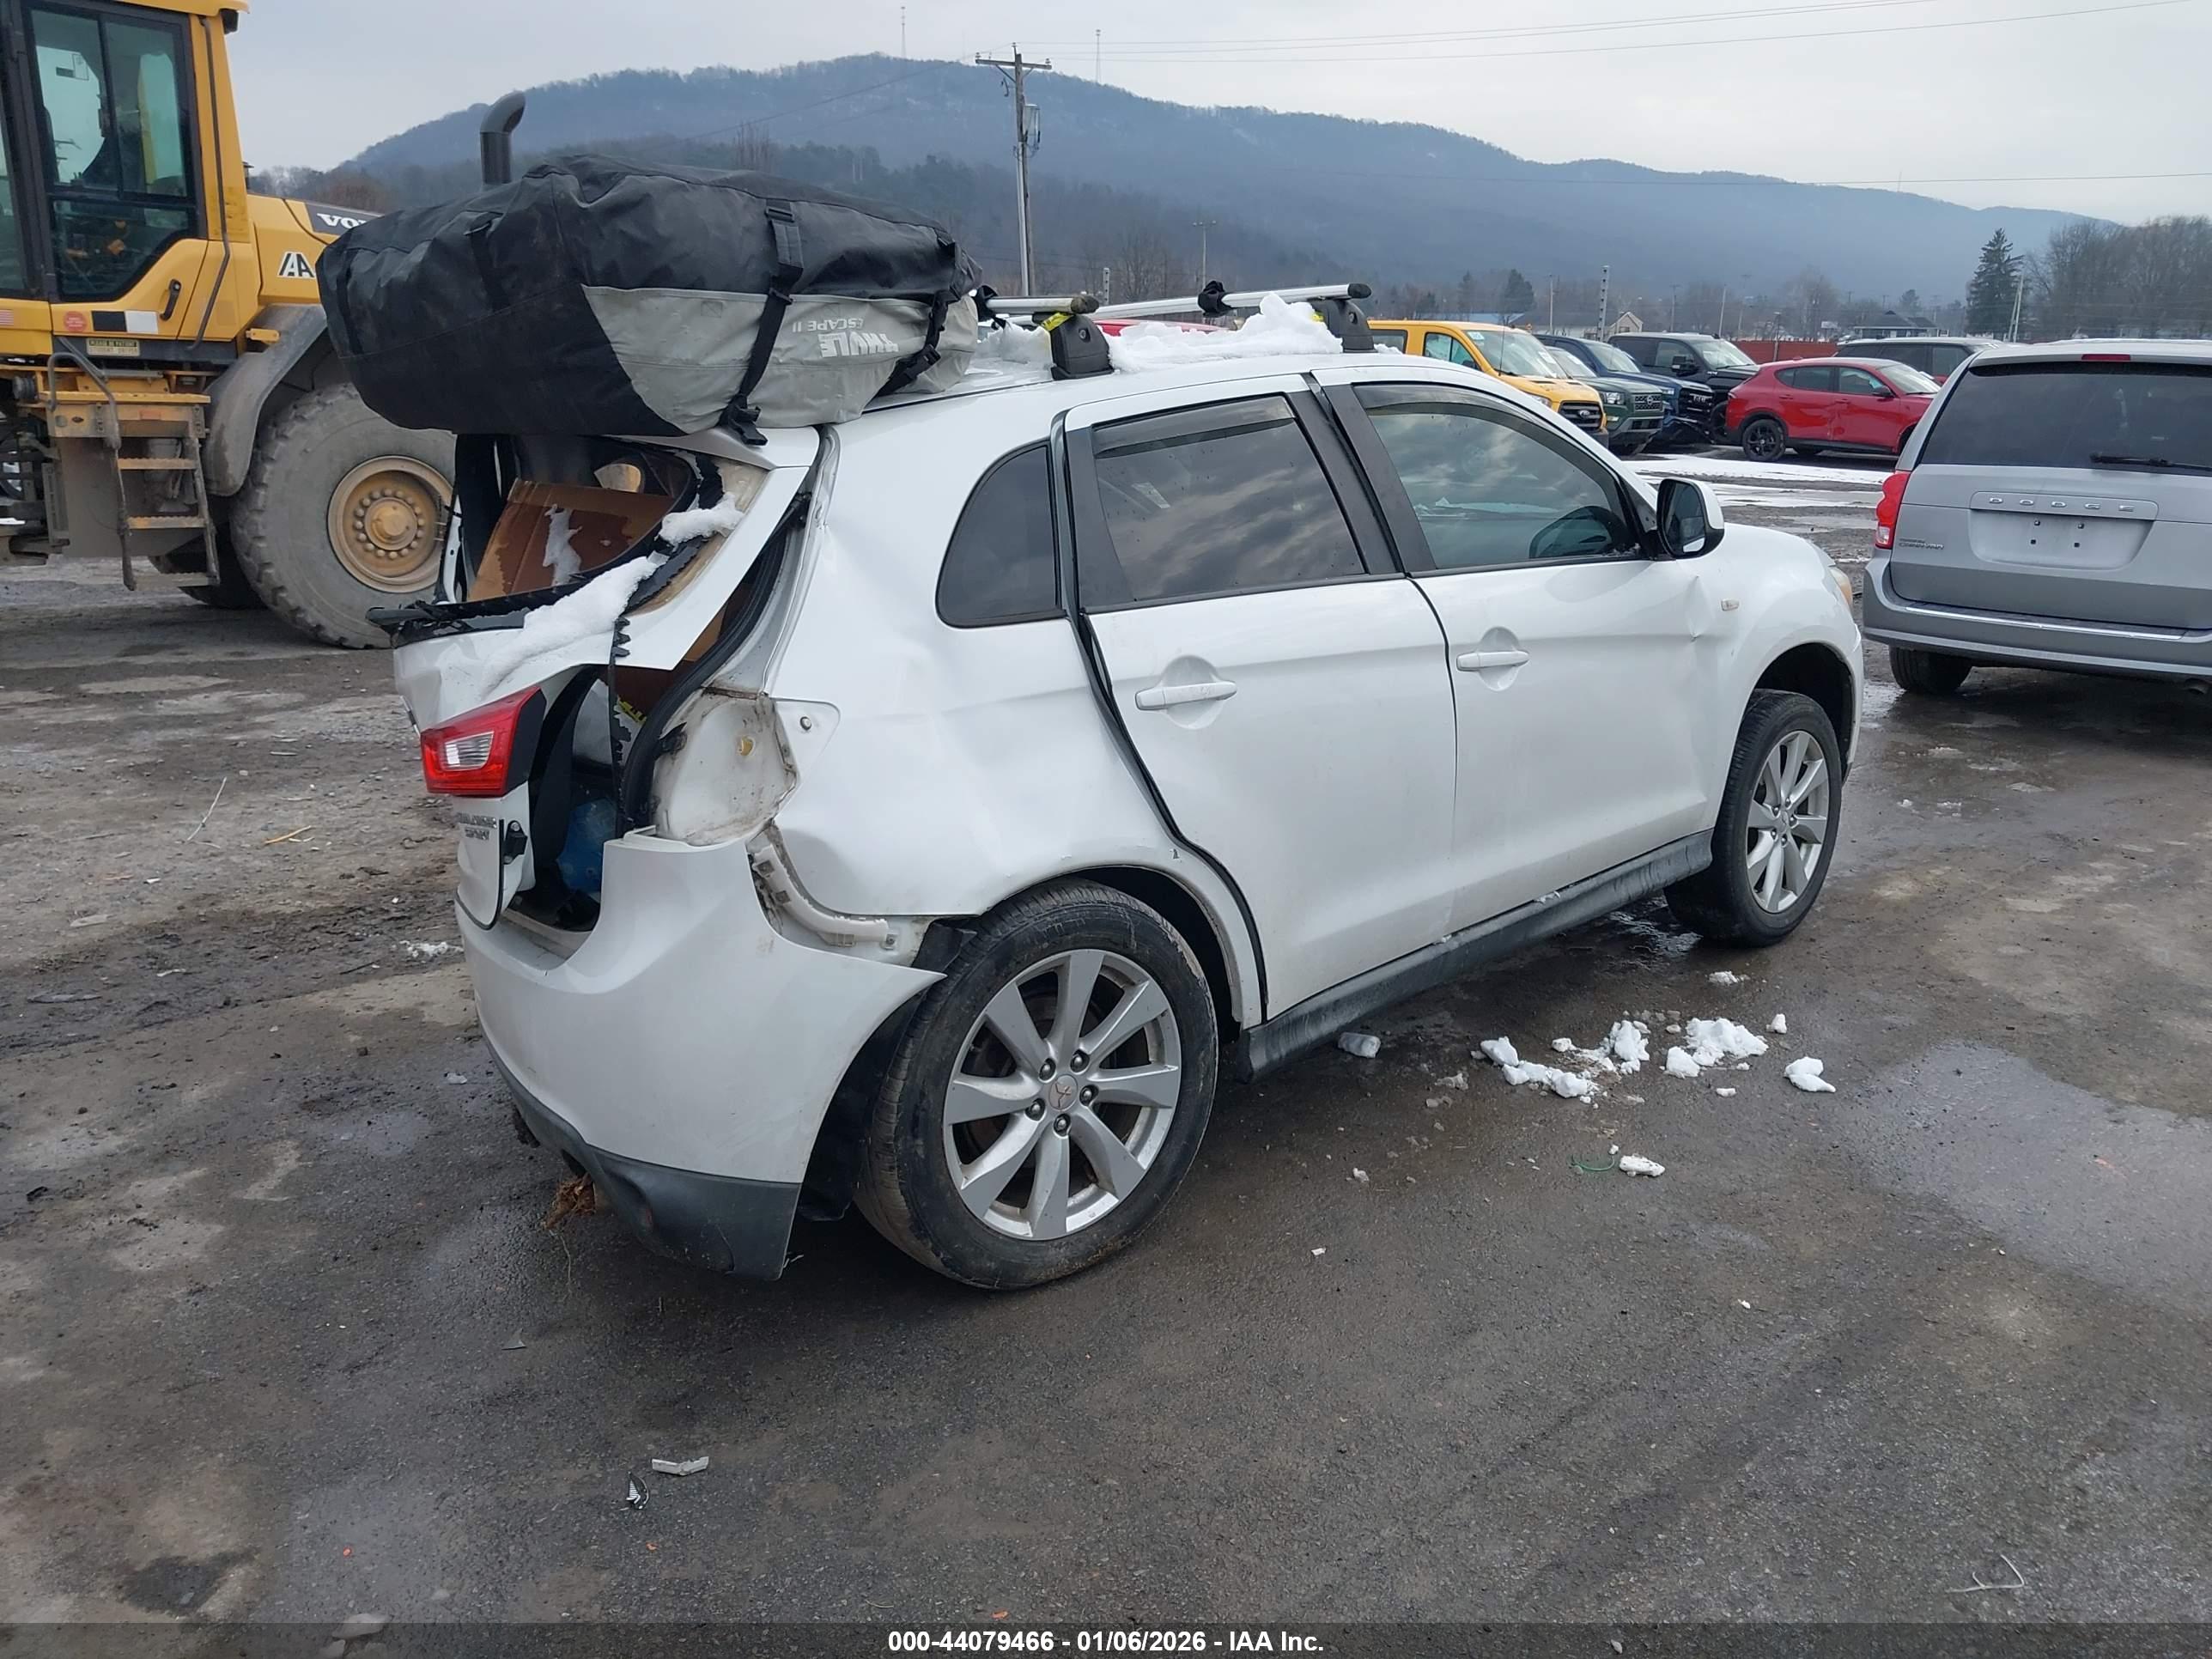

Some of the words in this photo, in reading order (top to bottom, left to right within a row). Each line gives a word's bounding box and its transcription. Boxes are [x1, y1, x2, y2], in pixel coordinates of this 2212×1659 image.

[317, 213, 367, 229] VO
[807, 318, 864, 331] ESCAPE
[817, 331, 899, 358] THULE
[1989, 496, 2135, 513] DODGE
